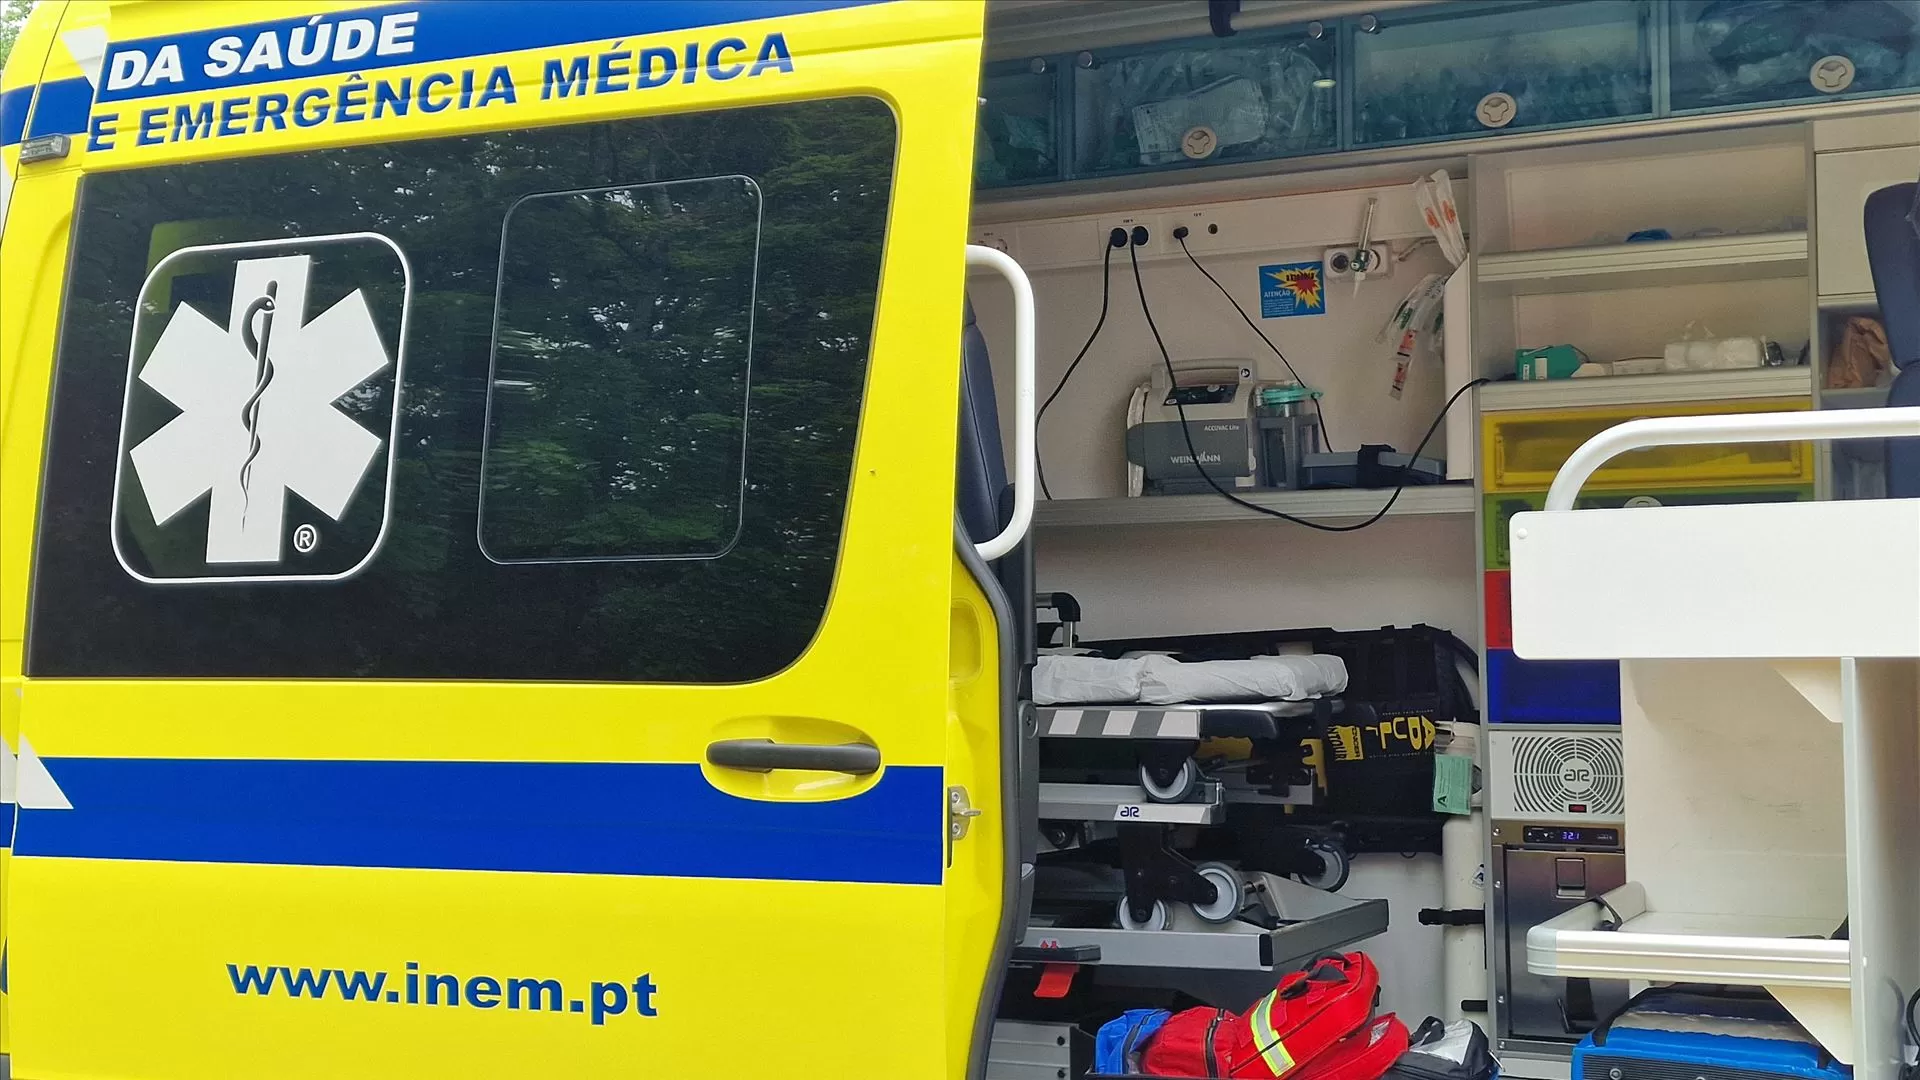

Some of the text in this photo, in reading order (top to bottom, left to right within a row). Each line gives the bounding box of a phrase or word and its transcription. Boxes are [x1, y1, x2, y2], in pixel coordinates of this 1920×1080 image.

[107, 12, 419, 91] DA SAÚDE
[86, 32, 795, 152] E EMERGÊNCIA MÉDICA
[226, 961, 658, 1025] www.inem.pt
